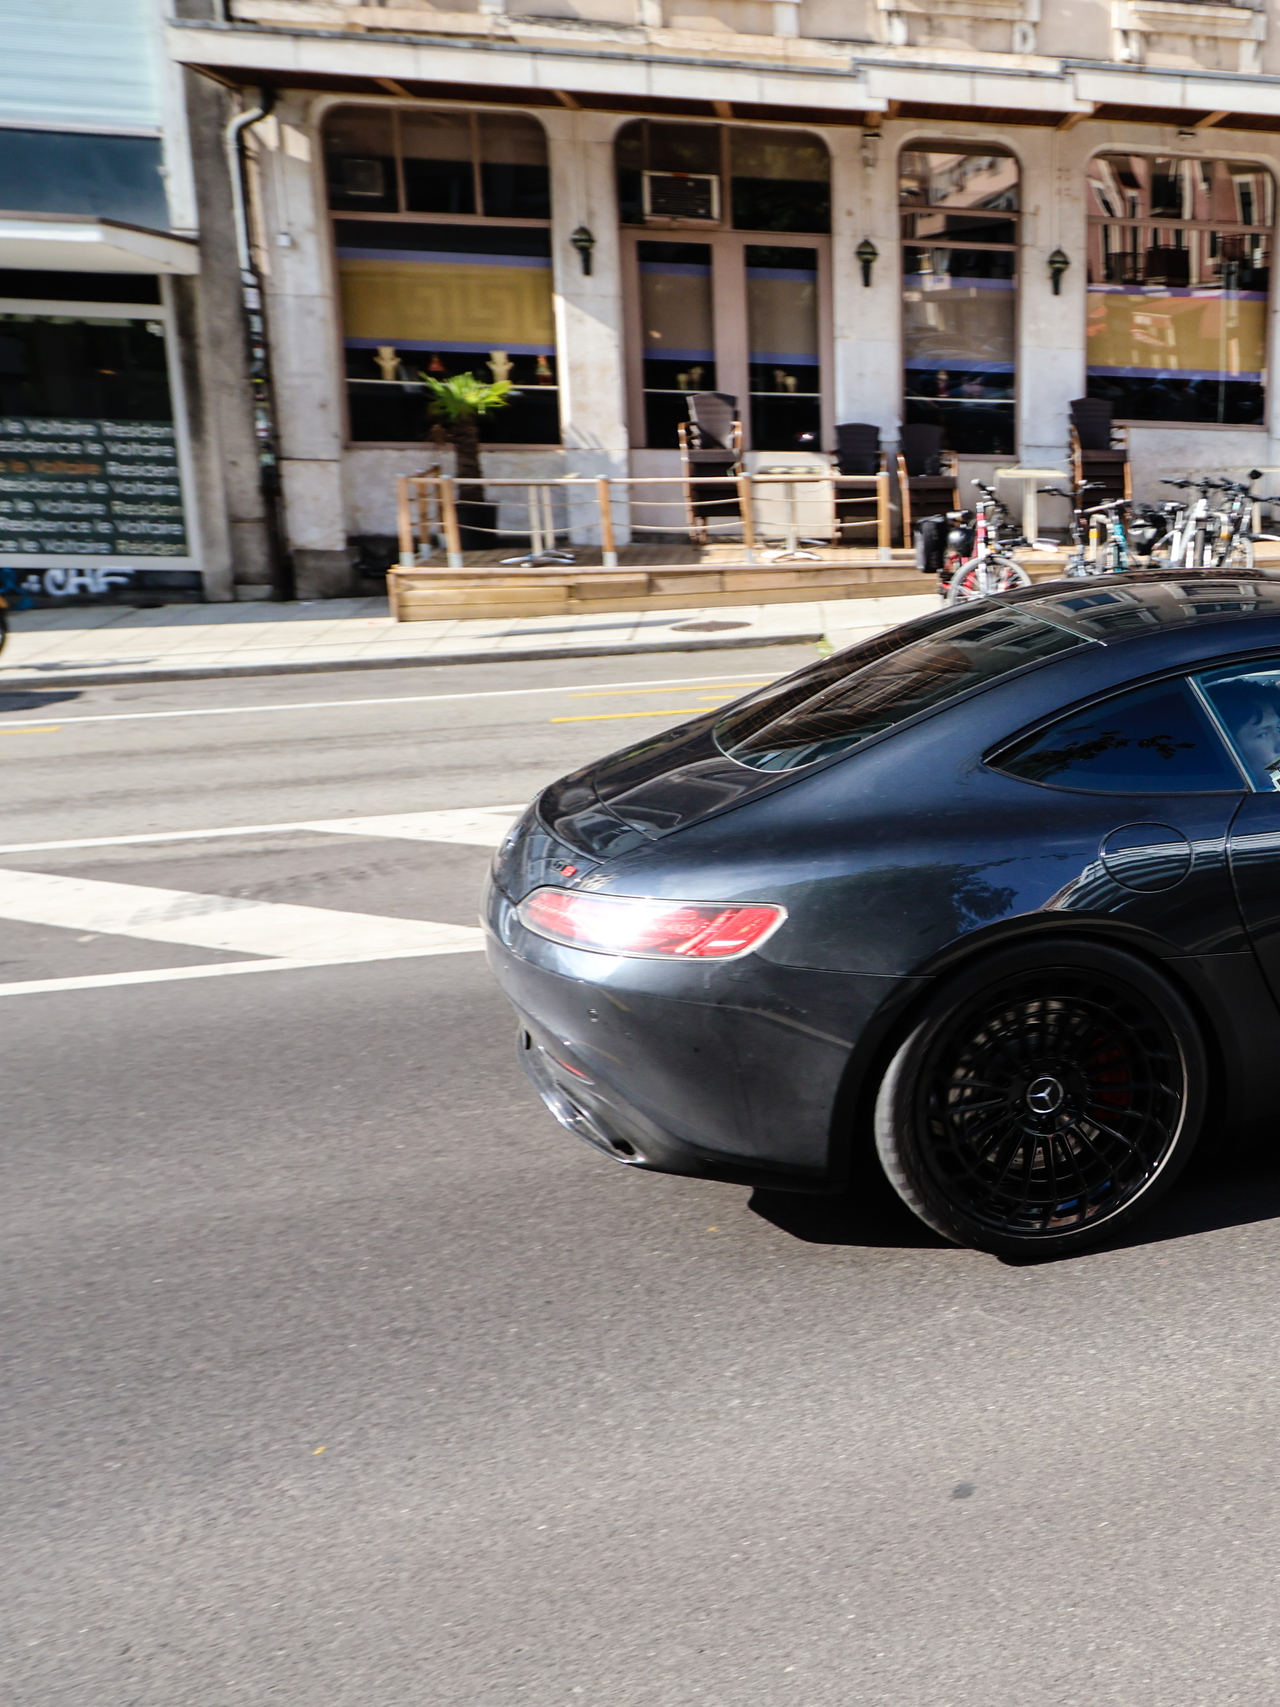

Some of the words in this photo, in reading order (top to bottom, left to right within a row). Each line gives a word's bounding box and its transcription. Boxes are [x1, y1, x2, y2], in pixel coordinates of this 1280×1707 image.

[24, 420, 98, 436] Voltaire
[83, 440, 104, 455] le
[104, 441, 175, 457] Voltaire
[88, 479, 109, 494] le
[109, 481, 179, 496] Voltaire
[14, 498, 35, 513] le
[35, 499, 106, 515] Voltaire
[92, 518, 114, 534] le
[114, 520, 184, 535] Voltaire
[18, 538, 40, 553] le
[40, 538, 112, 554] Voltaire
